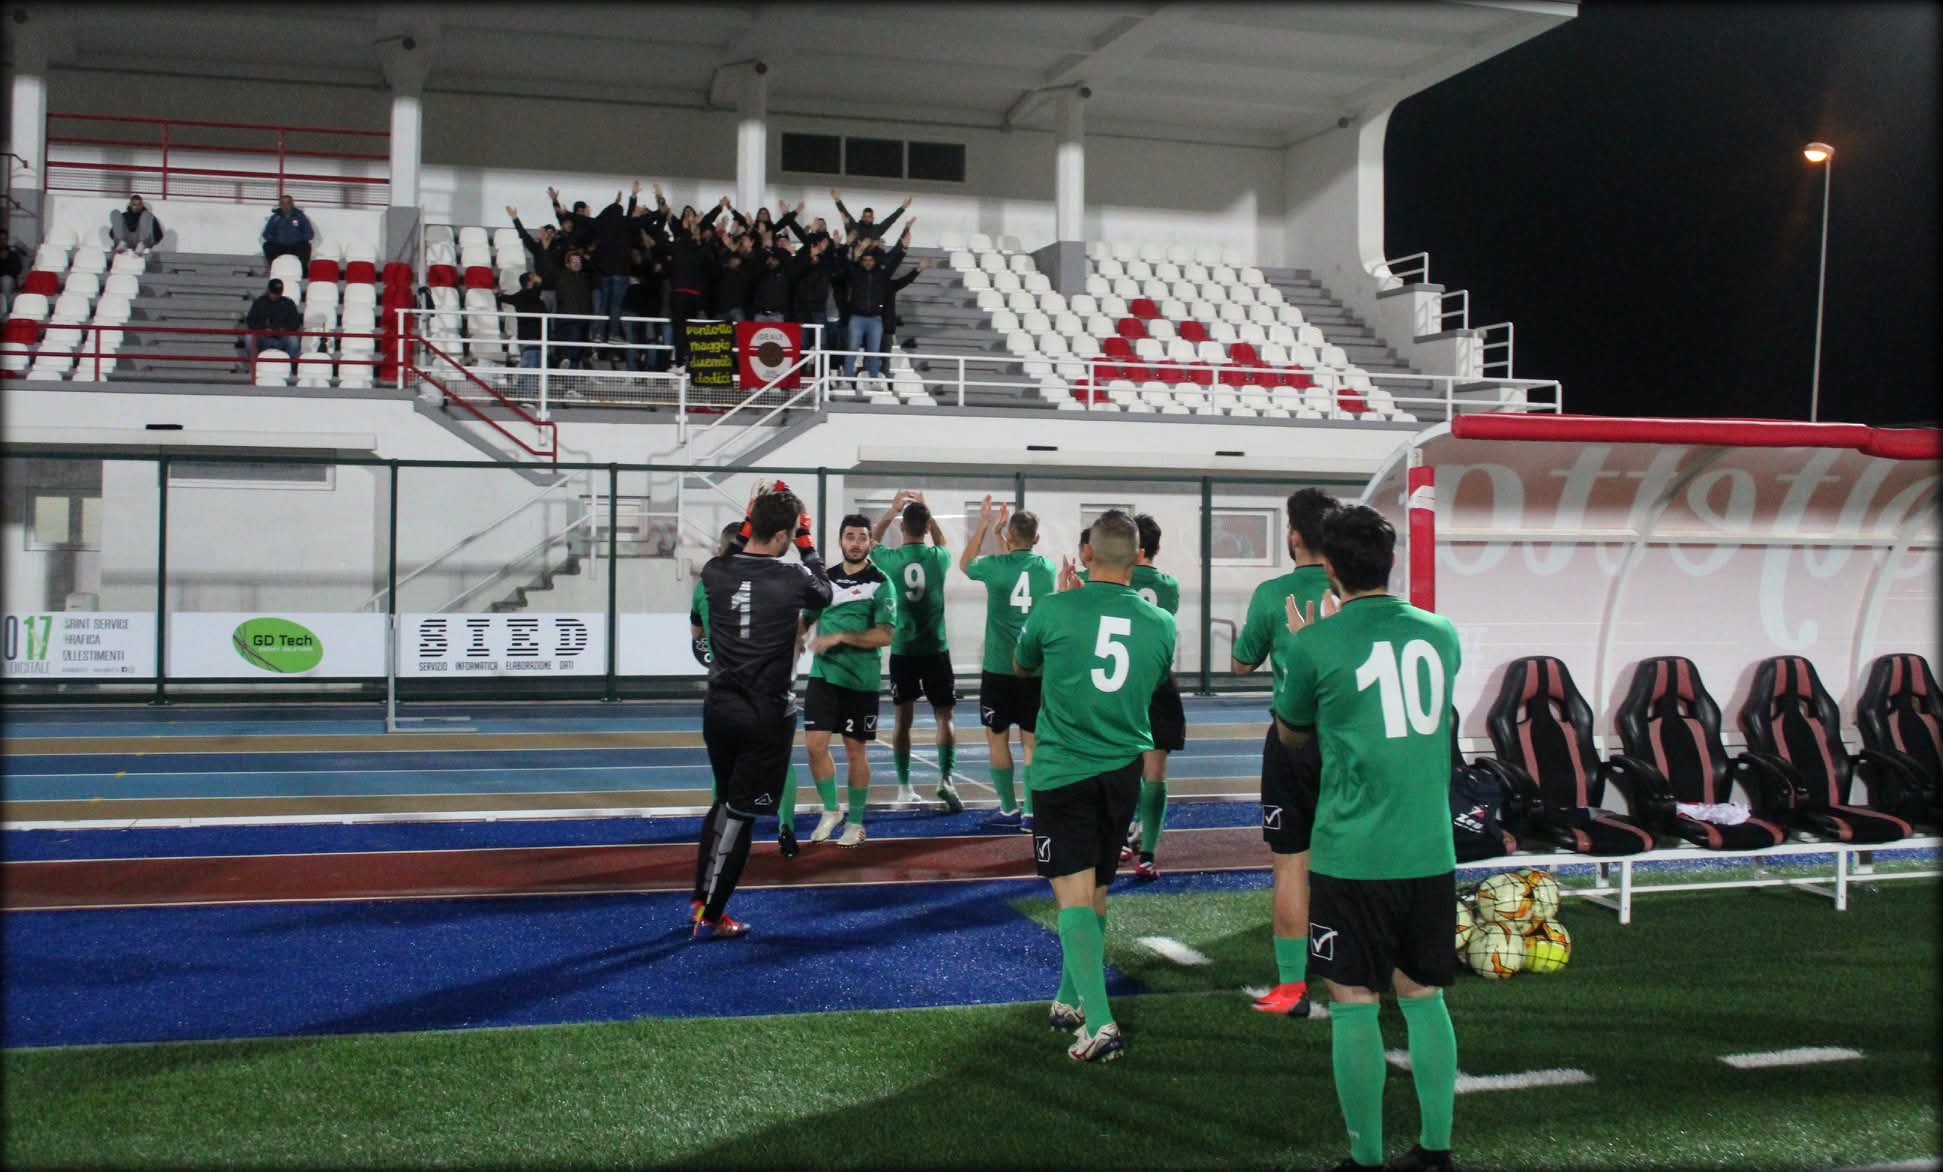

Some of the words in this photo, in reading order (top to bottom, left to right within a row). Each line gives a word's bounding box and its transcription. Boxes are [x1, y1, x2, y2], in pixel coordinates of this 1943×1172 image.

[903, 563, 927, 602] 9
[1009, 571, 1032, 614] 4
[94, 618, 129, 629] SERVICE
[730, 580, 753, 640] 1
[253, 634, 275, 646] GD
[279, 634, 313, 646] Tech
[419, 618, 588, 657] SIED
[1090, 615, 1132, 693] 5
[419, 662, 448, 672] SERVIZIO
[455, 661, 499, 671] INFORMATICA
[559, 660, 574, 670] DATI
[1355, 639, 1445, 738] 10
[845, 718, 854, 733] 2
